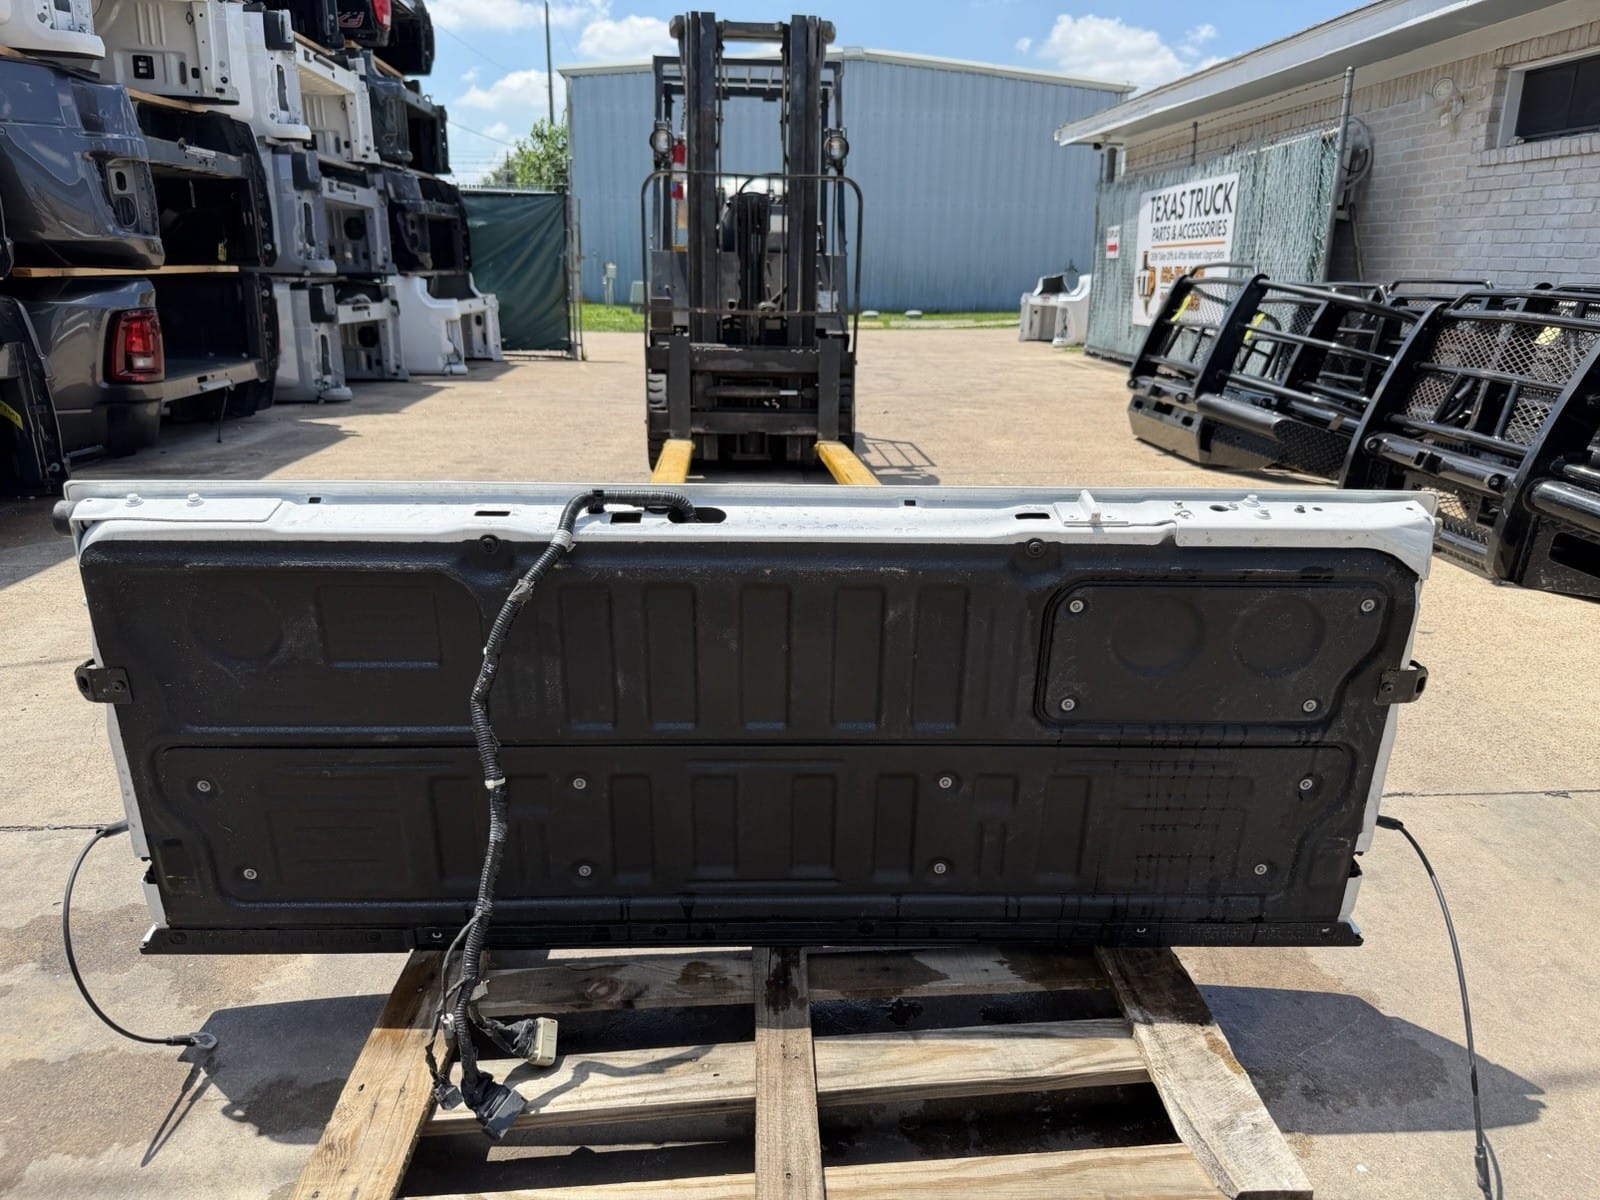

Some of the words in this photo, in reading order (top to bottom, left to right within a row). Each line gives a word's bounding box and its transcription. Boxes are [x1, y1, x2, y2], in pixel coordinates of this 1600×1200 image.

[1151, 190, 1186, 224] TEXAS
[1188, 181, 1235, 219] TRUCK
[1152, 225, 1171, 242] PARTS
[1171, 225, 1177, 241] &
[1177, 218, 1227, 240] ACCESSORIES
[1203, 249, 1225, 262] Upgrades
